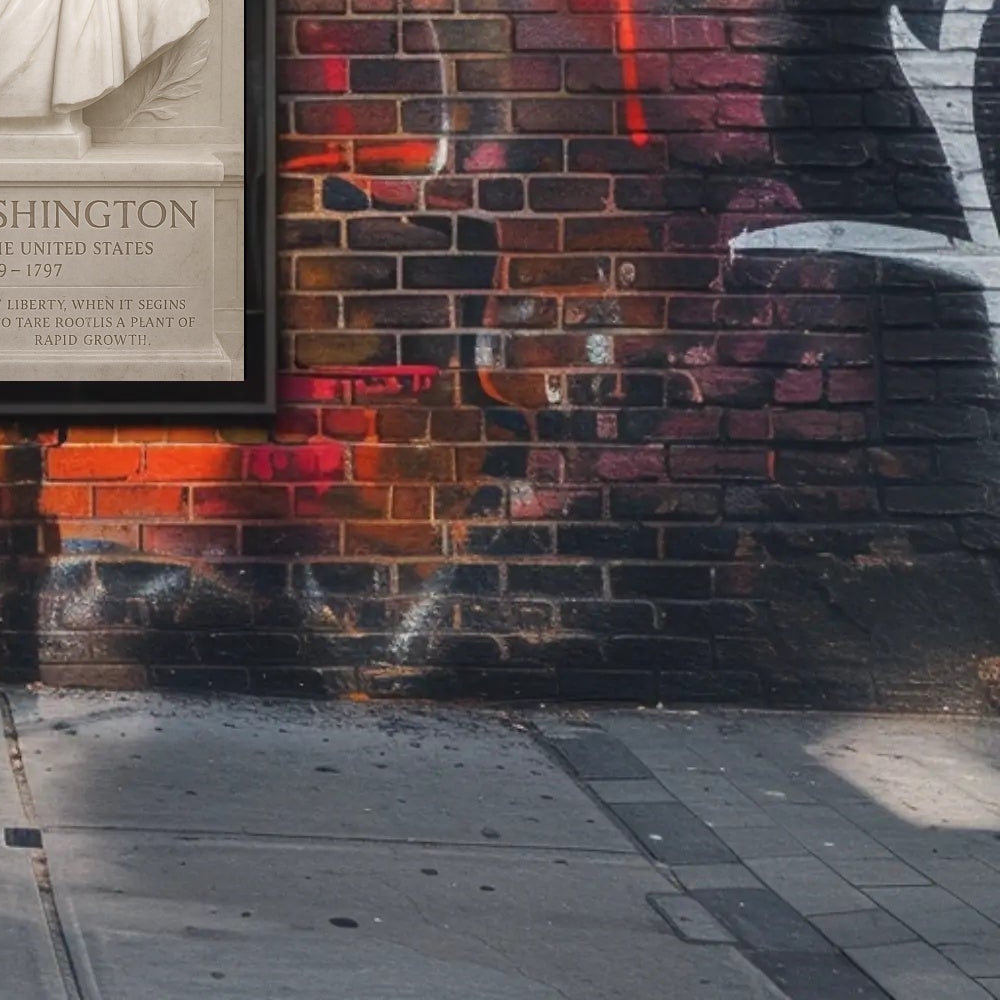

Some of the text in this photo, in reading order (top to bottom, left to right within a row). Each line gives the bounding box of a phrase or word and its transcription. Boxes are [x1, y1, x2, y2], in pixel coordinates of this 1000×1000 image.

[20, 241, 87, 256] UNITED
[93, 241, 154, 256] STATES
[72, 298, 115, 310] WHEN
[119, 298, 134, 310] IT
[116, 316, 126, 328] A
[130, 316, 175, 328] PLANT
[178, 316, 196, 328] OF
[34, 334, 152, 346] RAPID GROWTH.
